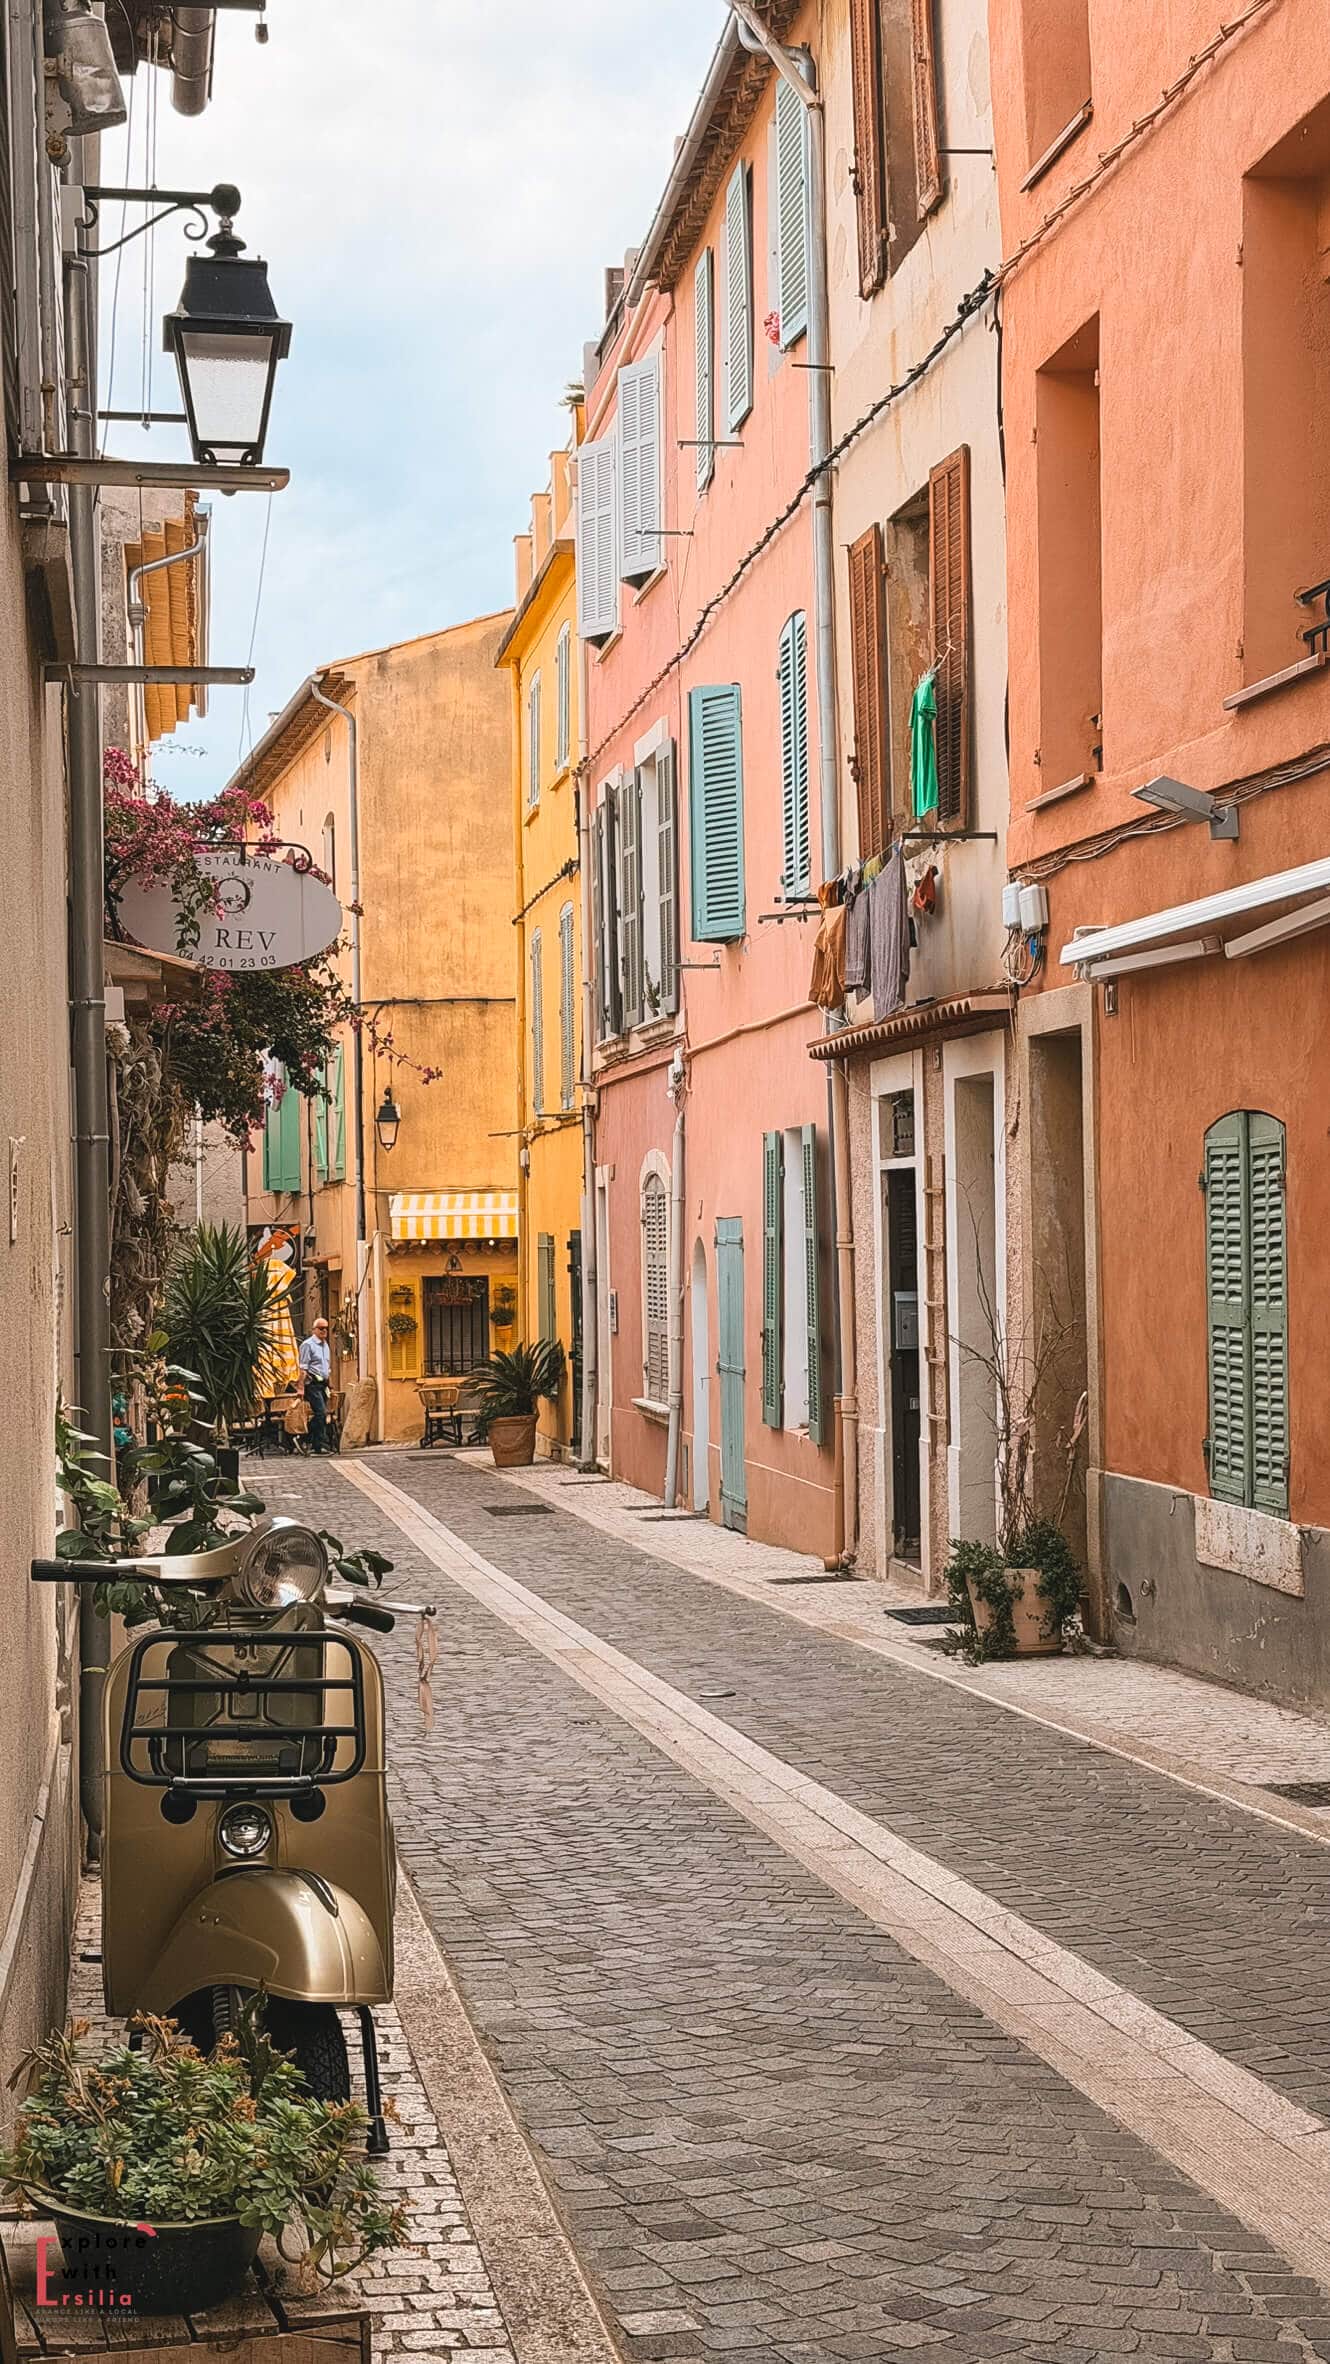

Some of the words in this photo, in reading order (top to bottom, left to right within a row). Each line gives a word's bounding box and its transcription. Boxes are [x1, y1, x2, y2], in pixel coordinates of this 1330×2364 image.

[188, 856, 282, 874] ESTAURANT
[215, 928, 277, 951] REV
[198, 954, 215, 966] 42
[219, 957, 234, 968] 01
[240, 955, 256, 968] 23
[261, 955, 277, 967] 03
